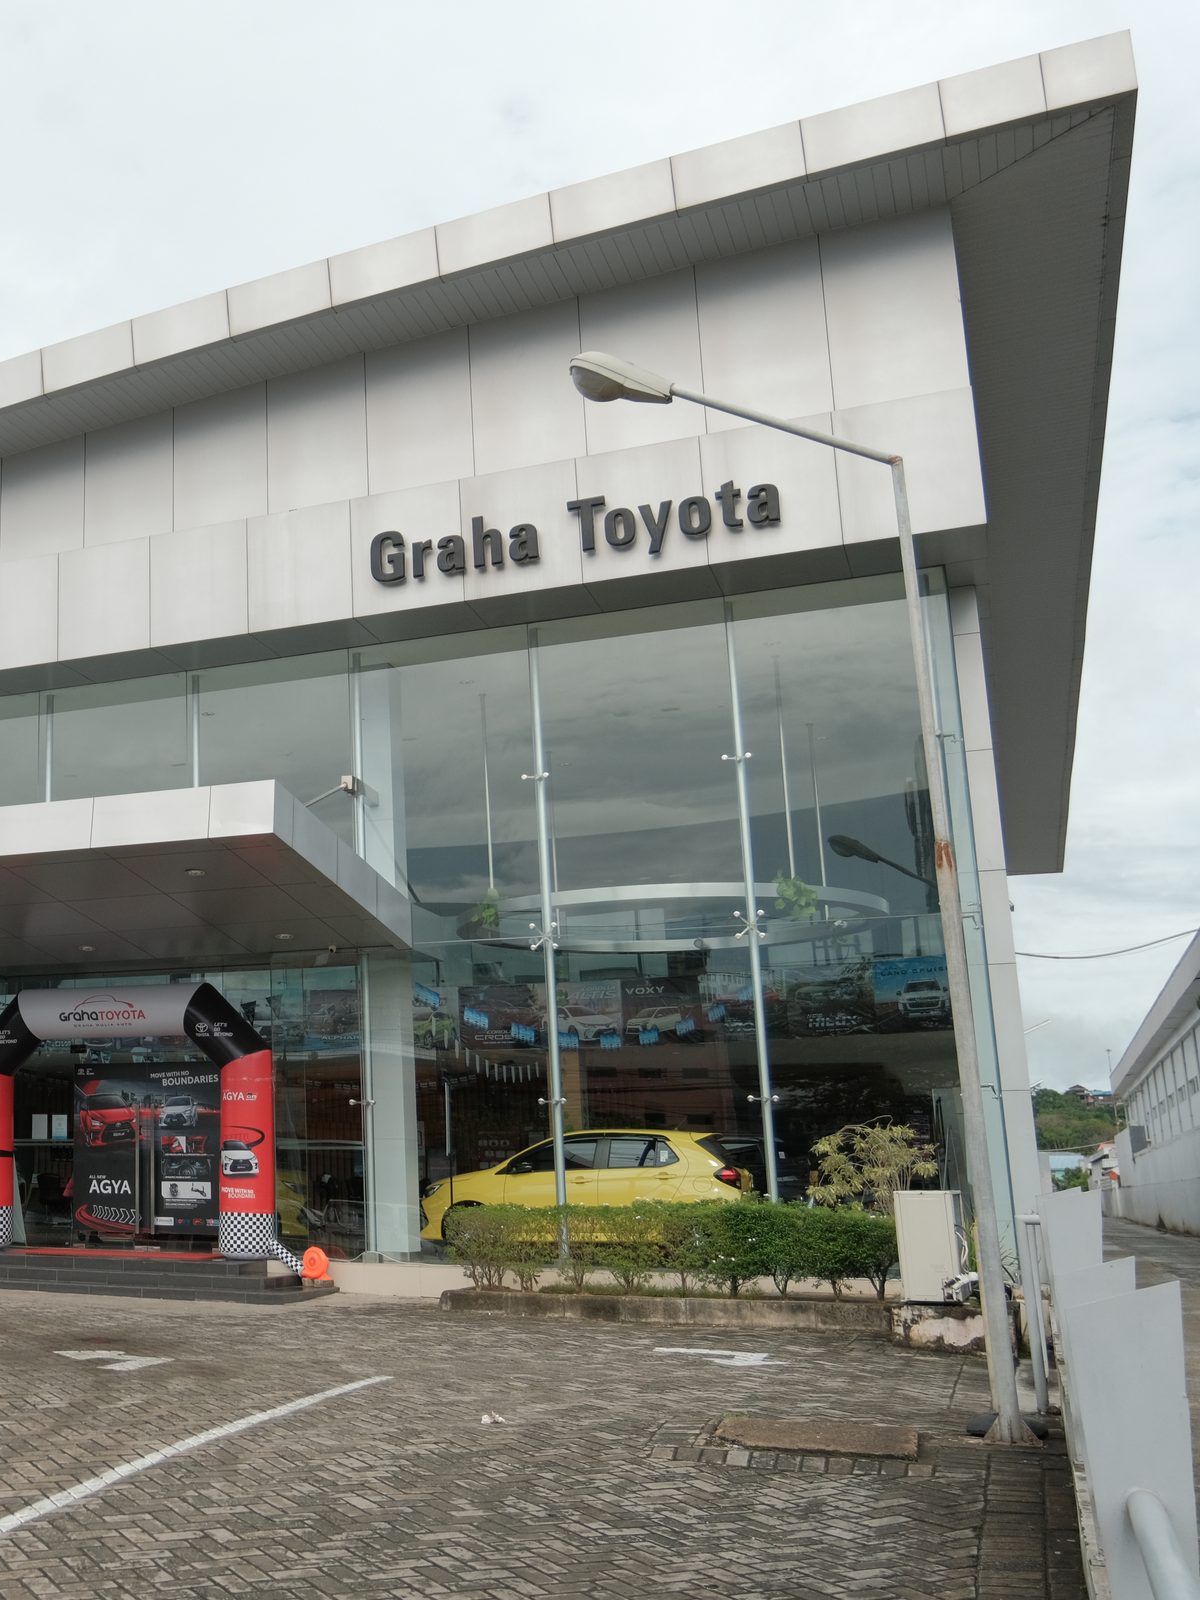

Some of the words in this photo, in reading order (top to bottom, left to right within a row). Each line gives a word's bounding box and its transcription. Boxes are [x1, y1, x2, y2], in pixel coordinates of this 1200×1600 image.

[370, 516, 540, 583] Graha
[566, 480, 781, 555] Toyota
[625, 986, 664, 994] VOXY
[162, 1074, 219, 1086] BOUNDARIES
[223, 1092, 244, 1100] AGYA
[89, 1180, 132, 1194] AGYA
